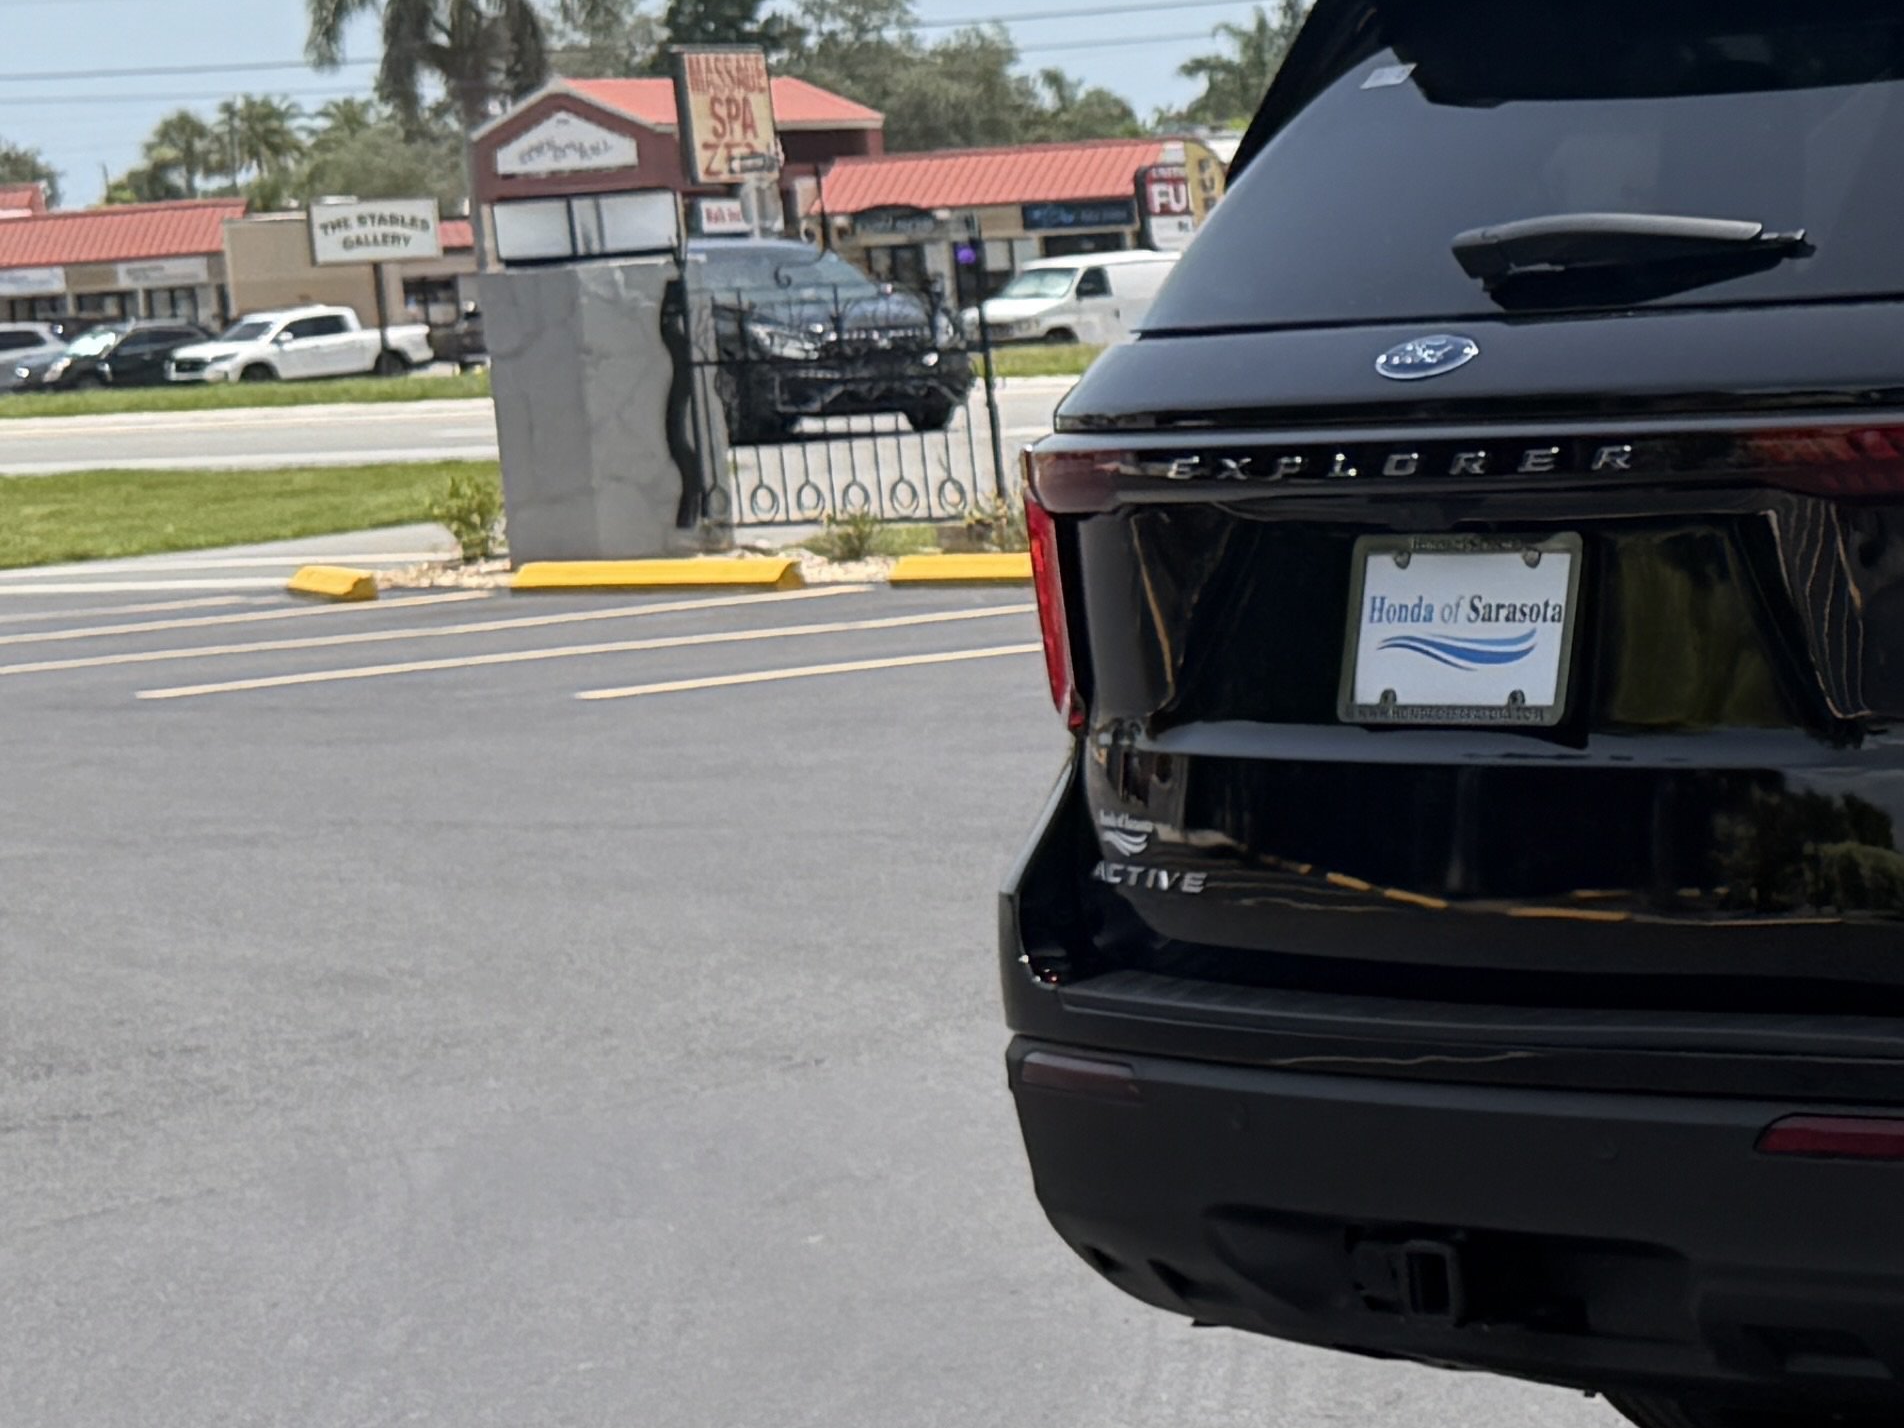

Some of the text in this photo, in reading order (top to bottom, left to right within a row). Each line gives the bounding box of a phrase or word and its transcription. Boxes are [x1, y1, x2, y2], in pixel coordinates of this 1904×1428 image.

[709, 95, 759, 141] SPA
[319, 217, 352, 237] THE
[1166, 444, 1633, 482] EXPLORER
[1368, 595, 1563, 624] Honda of Sarasota
[1092, 860, 1209, 894] ACTIVE
